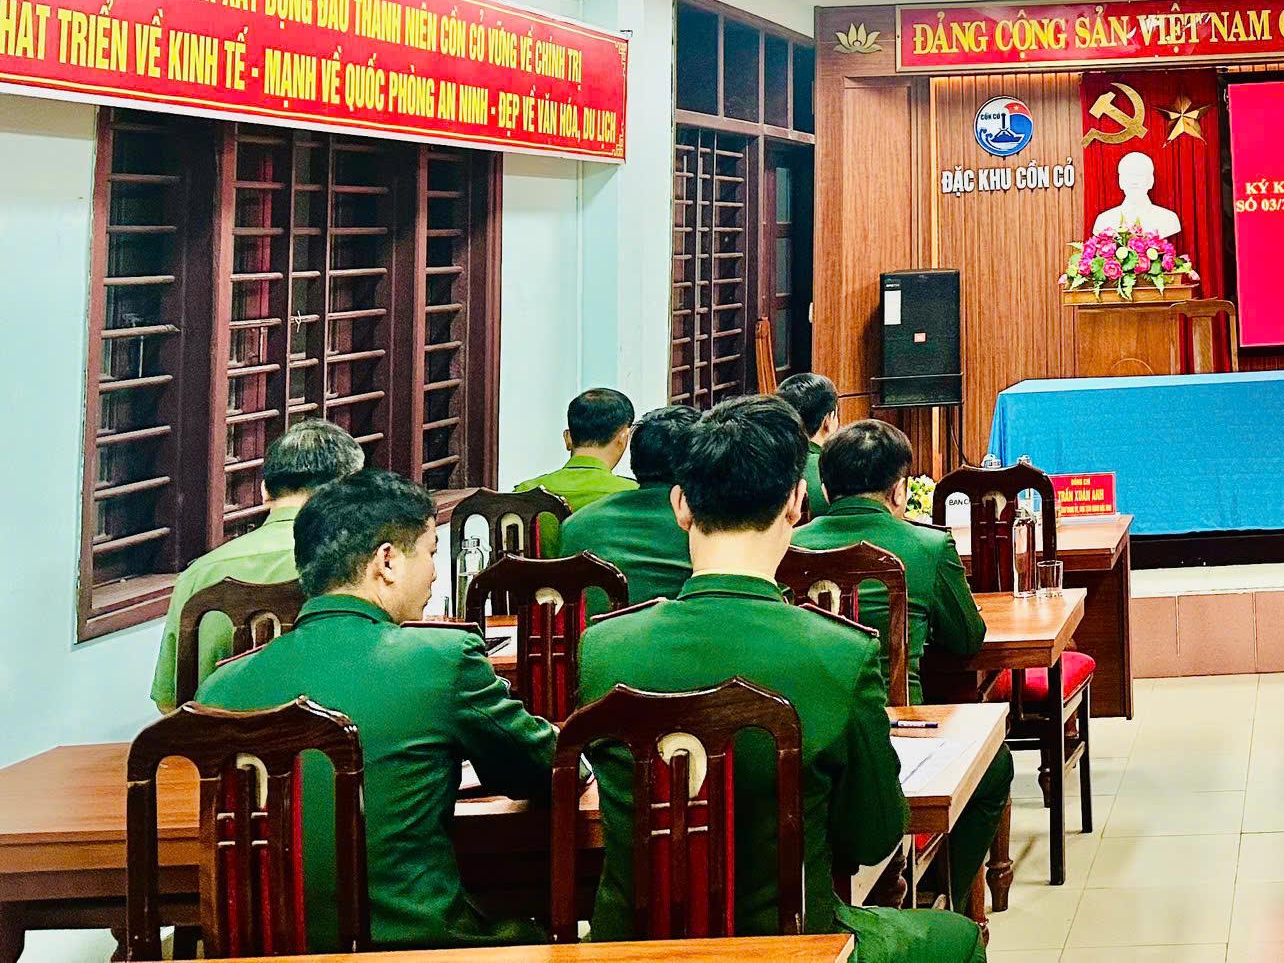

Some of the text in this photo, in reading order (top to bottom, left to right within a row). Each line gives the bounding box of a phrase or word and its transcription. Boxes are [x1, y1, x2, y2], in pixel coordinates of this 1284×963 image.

[405, 2, 437, 52] NIÊN
[440, 5, 467, 61] CỒN
[469, 9, 485, 62] CỎ
[488, 21, 517, 69] VỮNG
[520, 26, 535, 73] VỀ
[535, 36, 566, 81] CHÍNH
[568, 48, 582, 91] TRỊ
[913, 11, 988, 55] ĐẢNG
[995, 9, 1066, 59] CỘNG
[1075, 5, 1130, 49] SẢN
[1136, 2, 1204, 54] VIỆT
[1209, 9, 1273, 43] NAM
[135, 8, 164, 78] VỀ
[168, 30, 219, 86] KINH
[224, 26, 249, 90] TẾ
[251, 67, 259, 77] -
[264, 48, 317, 108] MẠNH
[321, 45, 343, 104] VỀ
[345, 53, 385, 112] QUỐC
[388, 64, 435, 118] PHÒNG
[437, 80, 457, 121] AN
[458, 84, 489, 125] NINH
[490, 106, 496, 115] -
[498, 90, 520, 137] ĐẸP
[523, 84, 536, 132] VỀ
[538, 93, 558, 136] VĂN
[560, 97, 581, 142] HÓA,
[583, 107, 596, 141] DU
[597, 110, 617, 149] LỊCH
[941, 157, 1075, 197] ĐẶC KHU CỒN CỎ
[1246, 179, 1269, 195] KÝ
